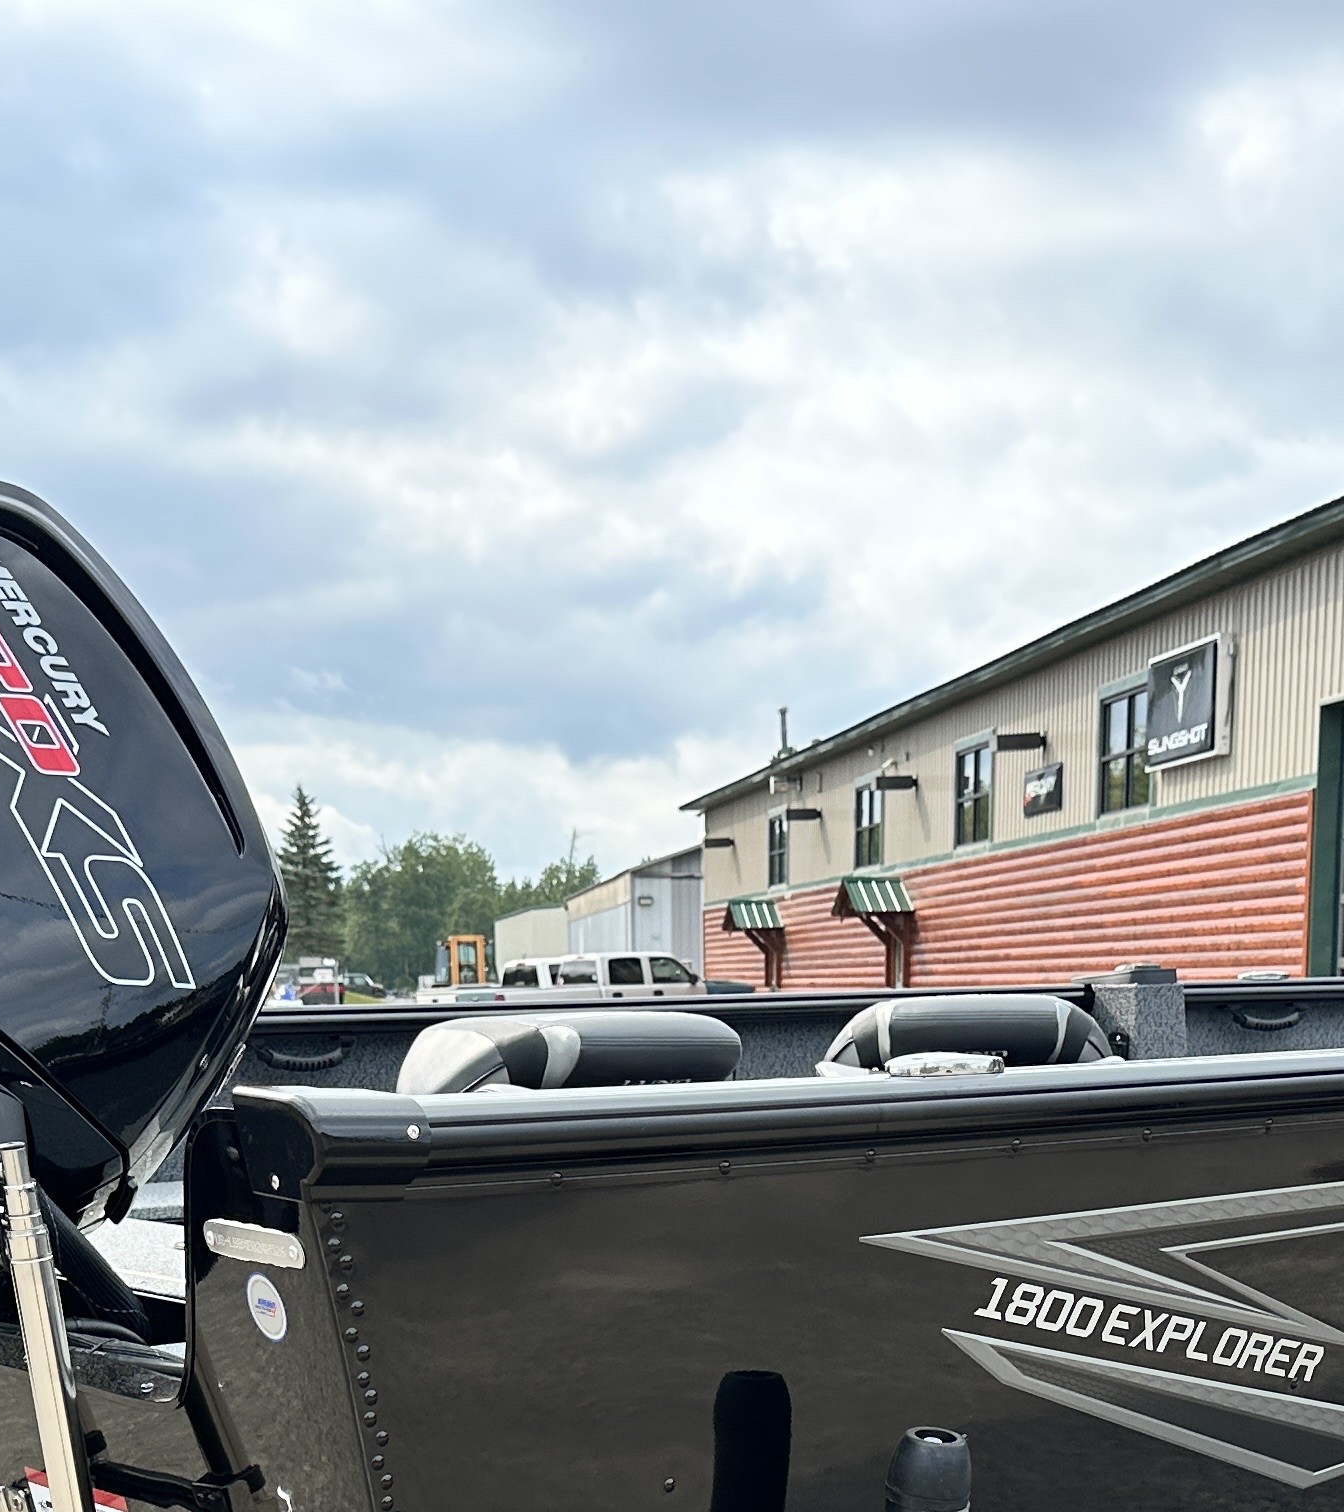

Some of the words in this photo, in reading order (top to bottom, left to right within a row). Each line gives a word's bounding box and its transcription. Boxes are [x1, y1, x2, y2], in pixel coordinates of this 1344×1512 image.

[1147, 722, 1208, 756] SLINGSHOT
[973, 1277, 1101, 1339] 1800
[1101, 1304, 1325, 1384] EXPLORER
